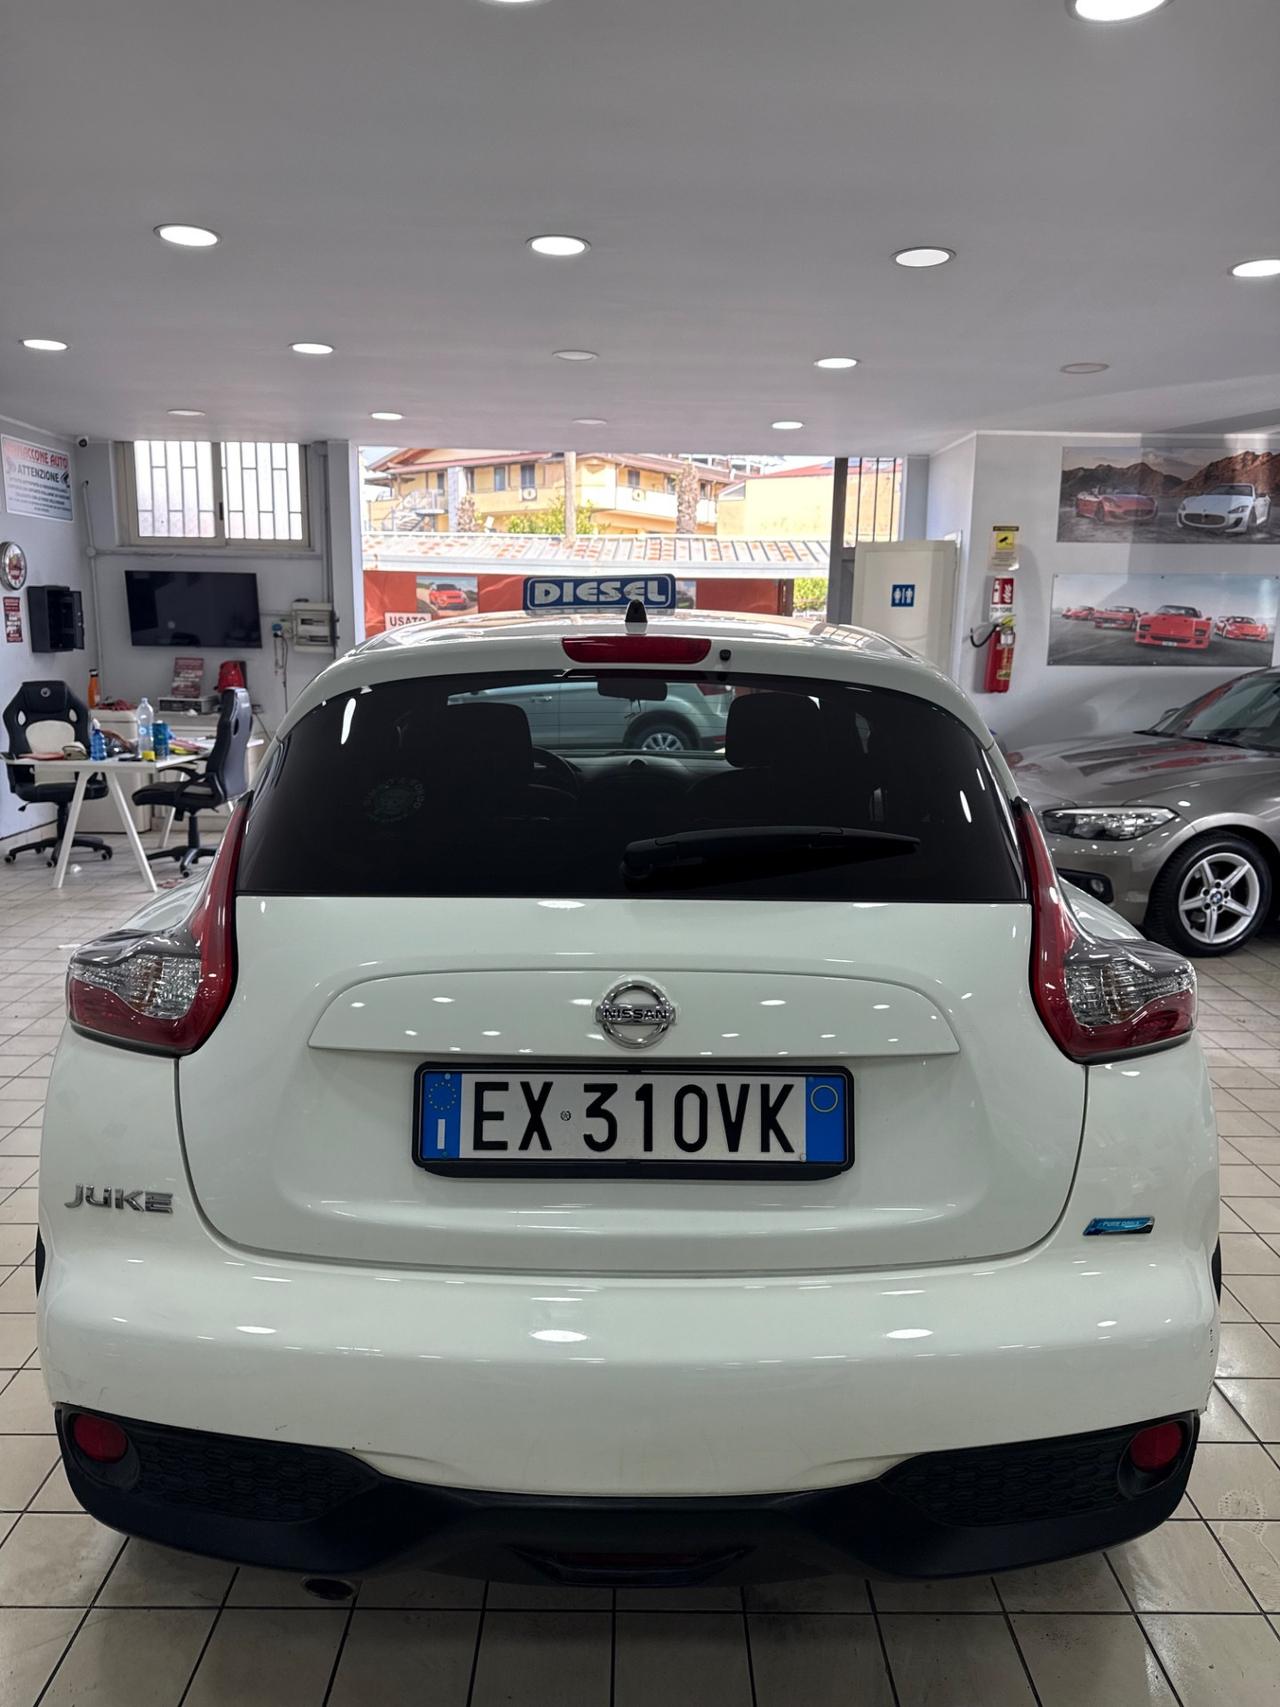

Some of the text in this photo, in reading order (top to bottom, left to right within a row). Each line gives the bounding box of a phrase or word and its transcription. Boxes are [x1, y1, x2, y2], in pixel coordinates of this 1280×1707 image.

[17, 464, 60, 483] ATTENZIONE
[534, 580, 667, 604] DIESEL
[604, 1008, 667, 1019] NISSAN
[472, 1081, 554, 1151] EX
[582, 1082, 795, 1153] 310VK
[64, 1183, 173, 1214] JUKE
